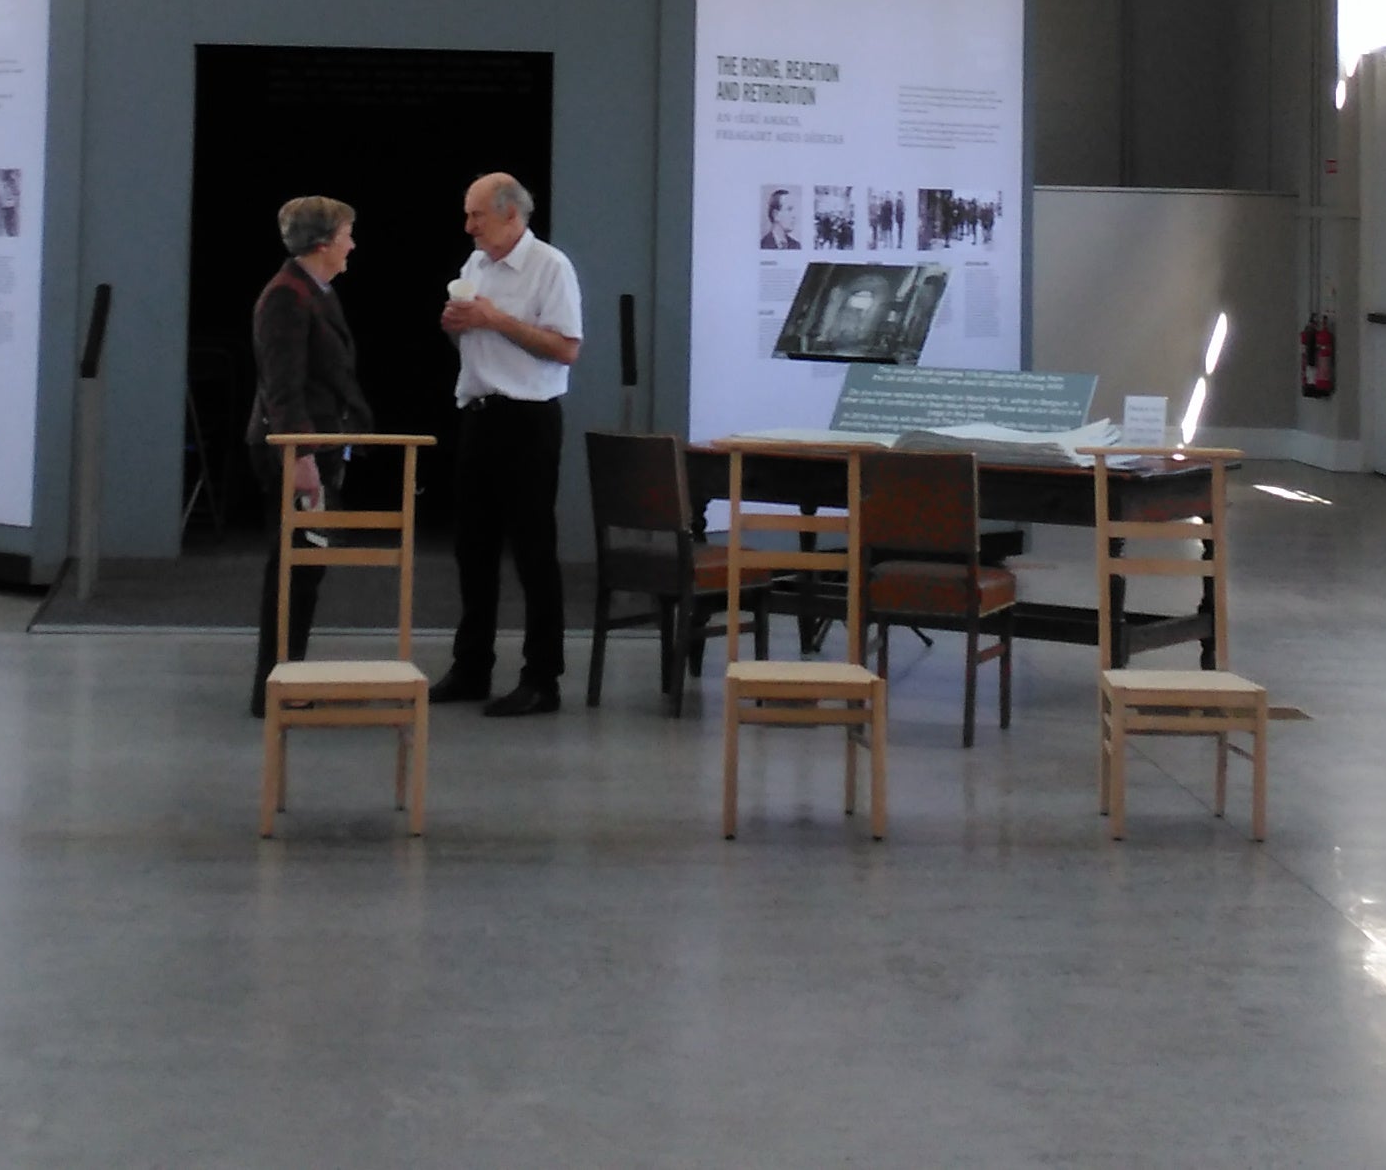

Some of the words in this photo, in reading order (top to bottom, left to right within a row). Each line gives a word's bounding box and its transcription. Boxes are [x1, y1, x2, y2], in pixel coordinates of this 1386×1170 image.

[717, 55, 738, 76] THE
[786, 60, 840, 83] REACTION
[715, 81, 740, 101] AND
[742, 82, 816, 105] RETRIBUTION
